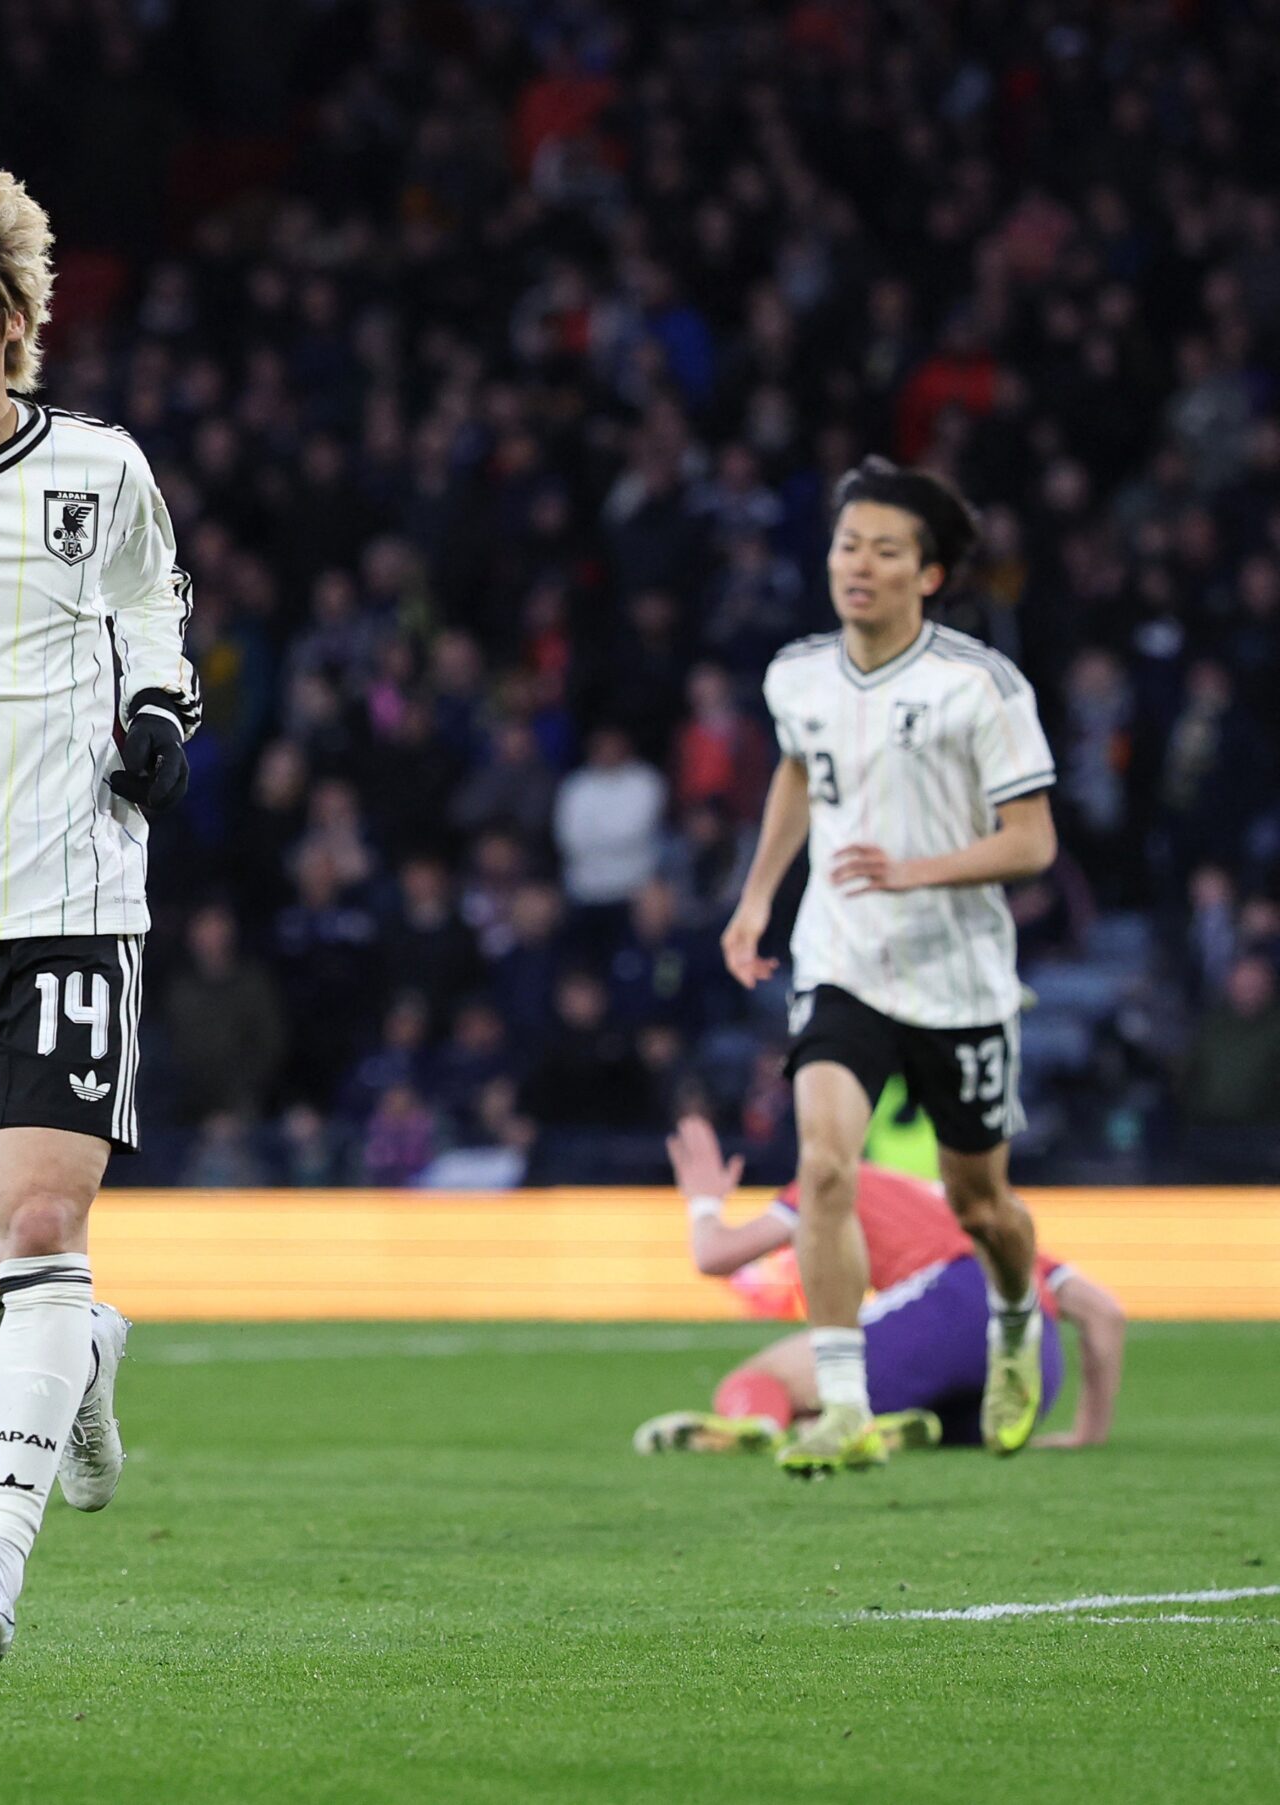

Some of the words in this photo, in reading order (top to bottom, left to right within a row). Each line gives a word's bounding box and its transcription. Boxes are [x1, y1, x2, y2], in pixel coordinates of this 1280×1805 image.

[56, 491, 88, 501] JAPAN
[58, 541, 84, 555] JFA
[34, 971, 110, 1060] 14
[954, 1036, 1005, 1103] 13
